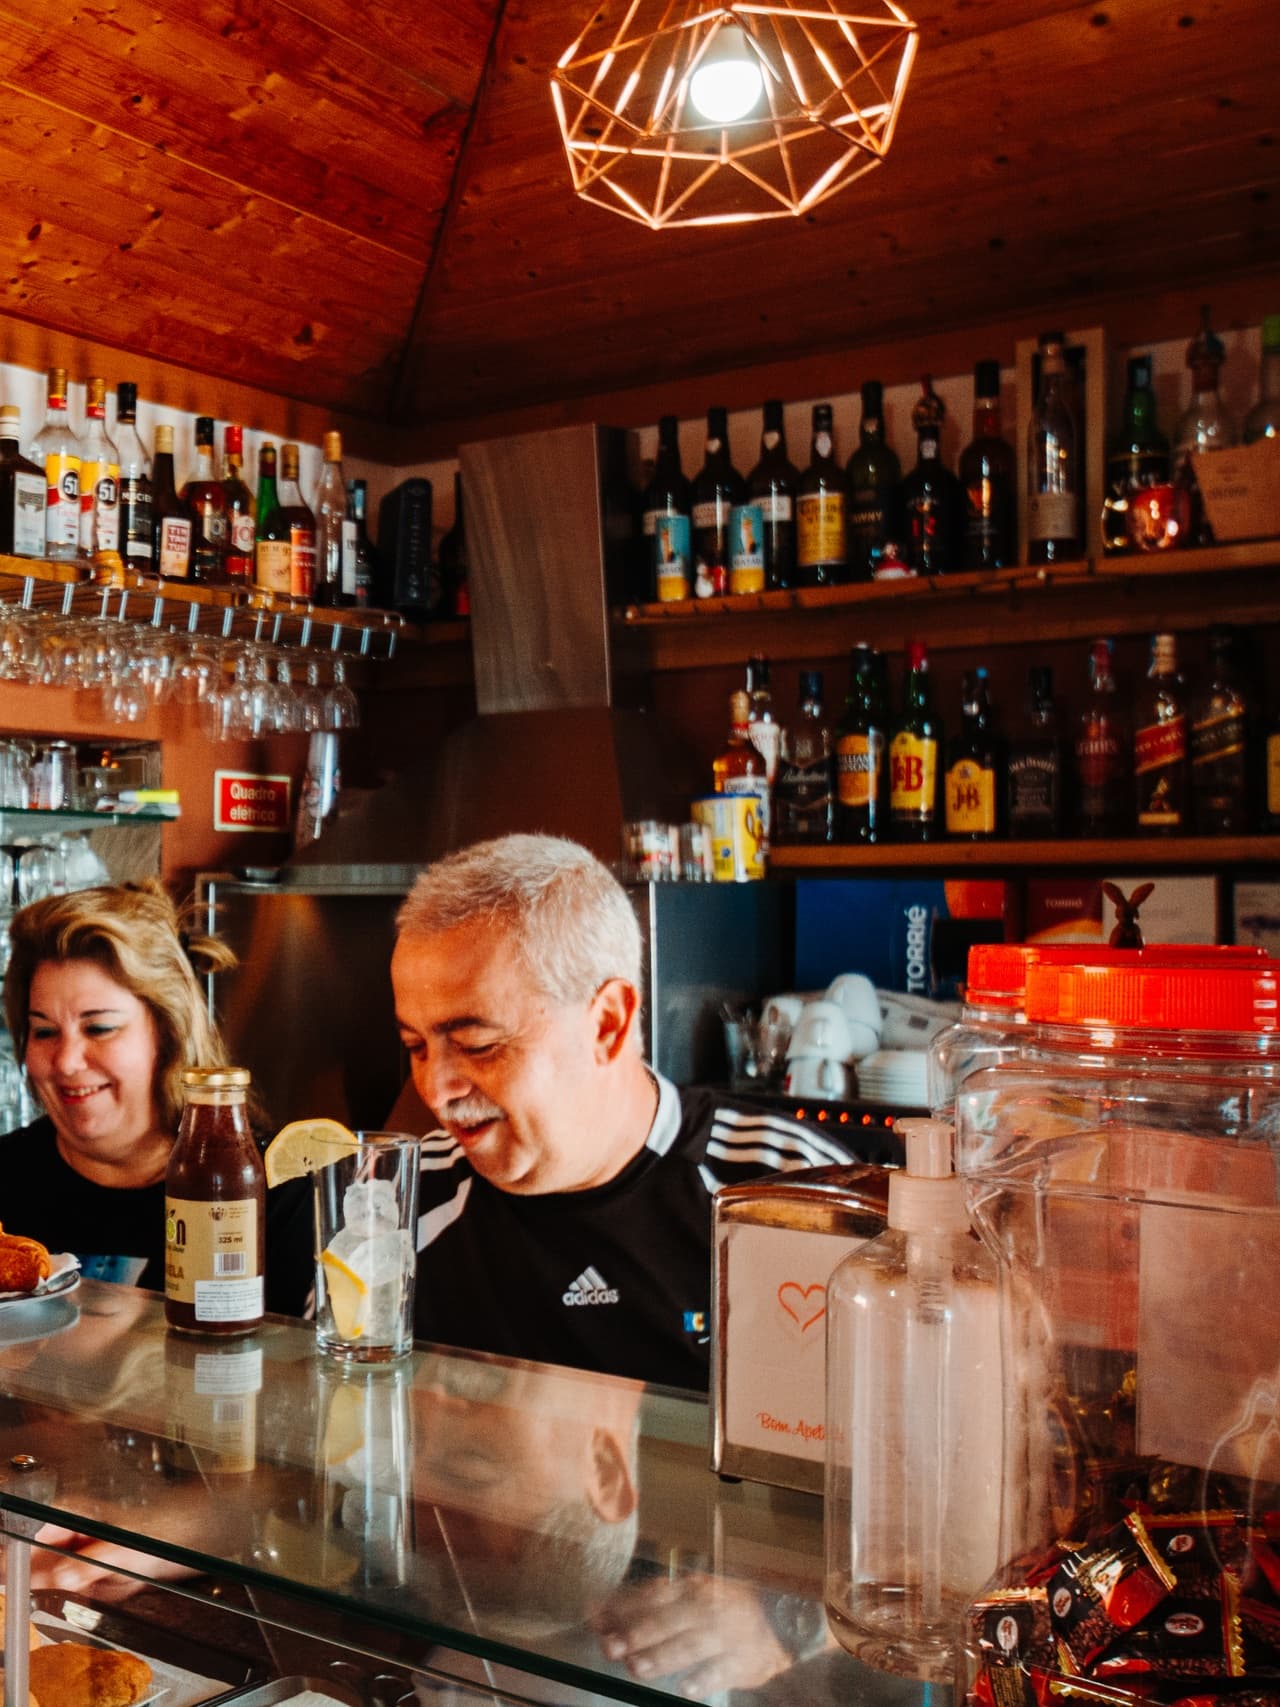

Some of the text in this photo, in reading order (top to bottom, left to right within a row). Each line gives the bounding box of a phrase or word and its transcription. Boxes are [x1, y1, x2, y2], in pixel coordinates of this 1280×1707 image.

[64, 479, 78, 495] 51
[99, 483, 116, 502] 51
[230, 781, 276, 801] Quadro
[230, 804, 276, 821] elétrico
[562, 1288, 620, 1306] adidas
[756, 1412, 791, 1433] Bom
